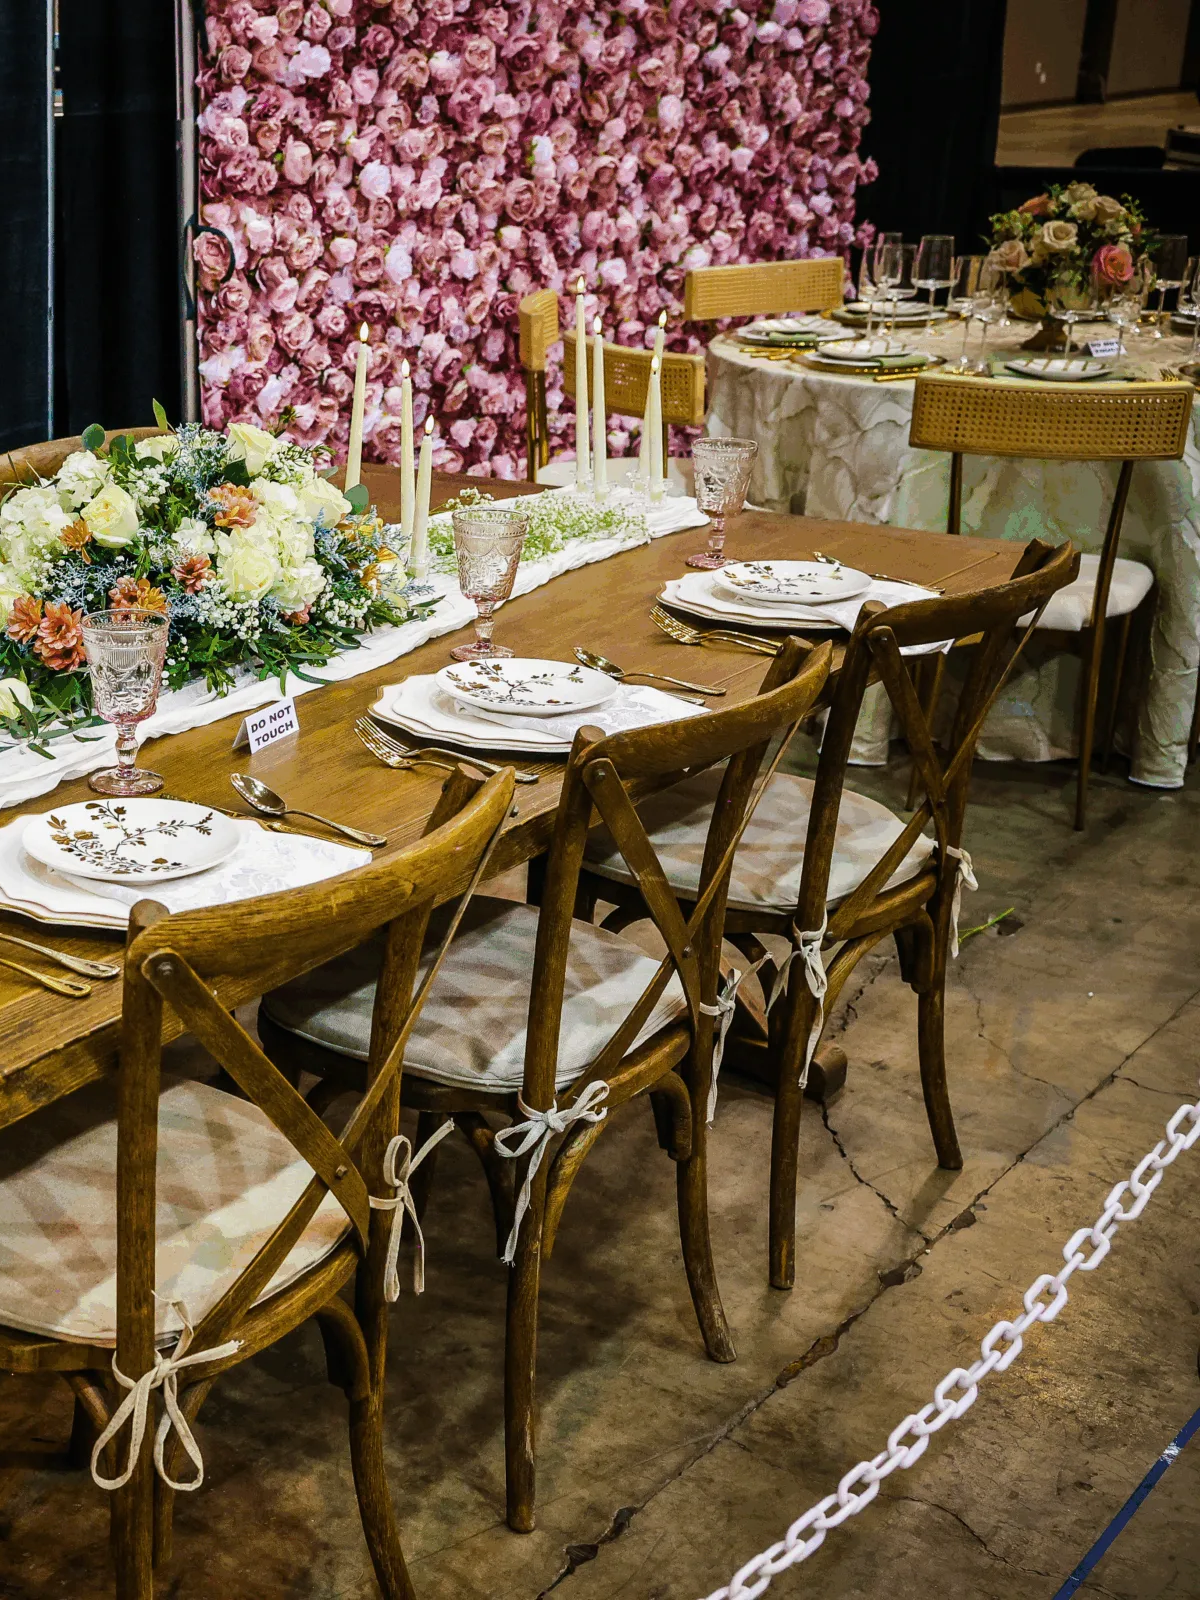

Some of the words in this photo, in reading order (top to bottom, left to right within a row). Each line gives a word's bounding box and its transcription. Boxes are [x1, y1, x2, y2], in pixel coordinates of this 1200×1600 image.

[250, 719, 266, 733] DO
[269, 705, 291, 723] NOT
[254, 720, 294, 746] TOUCH
